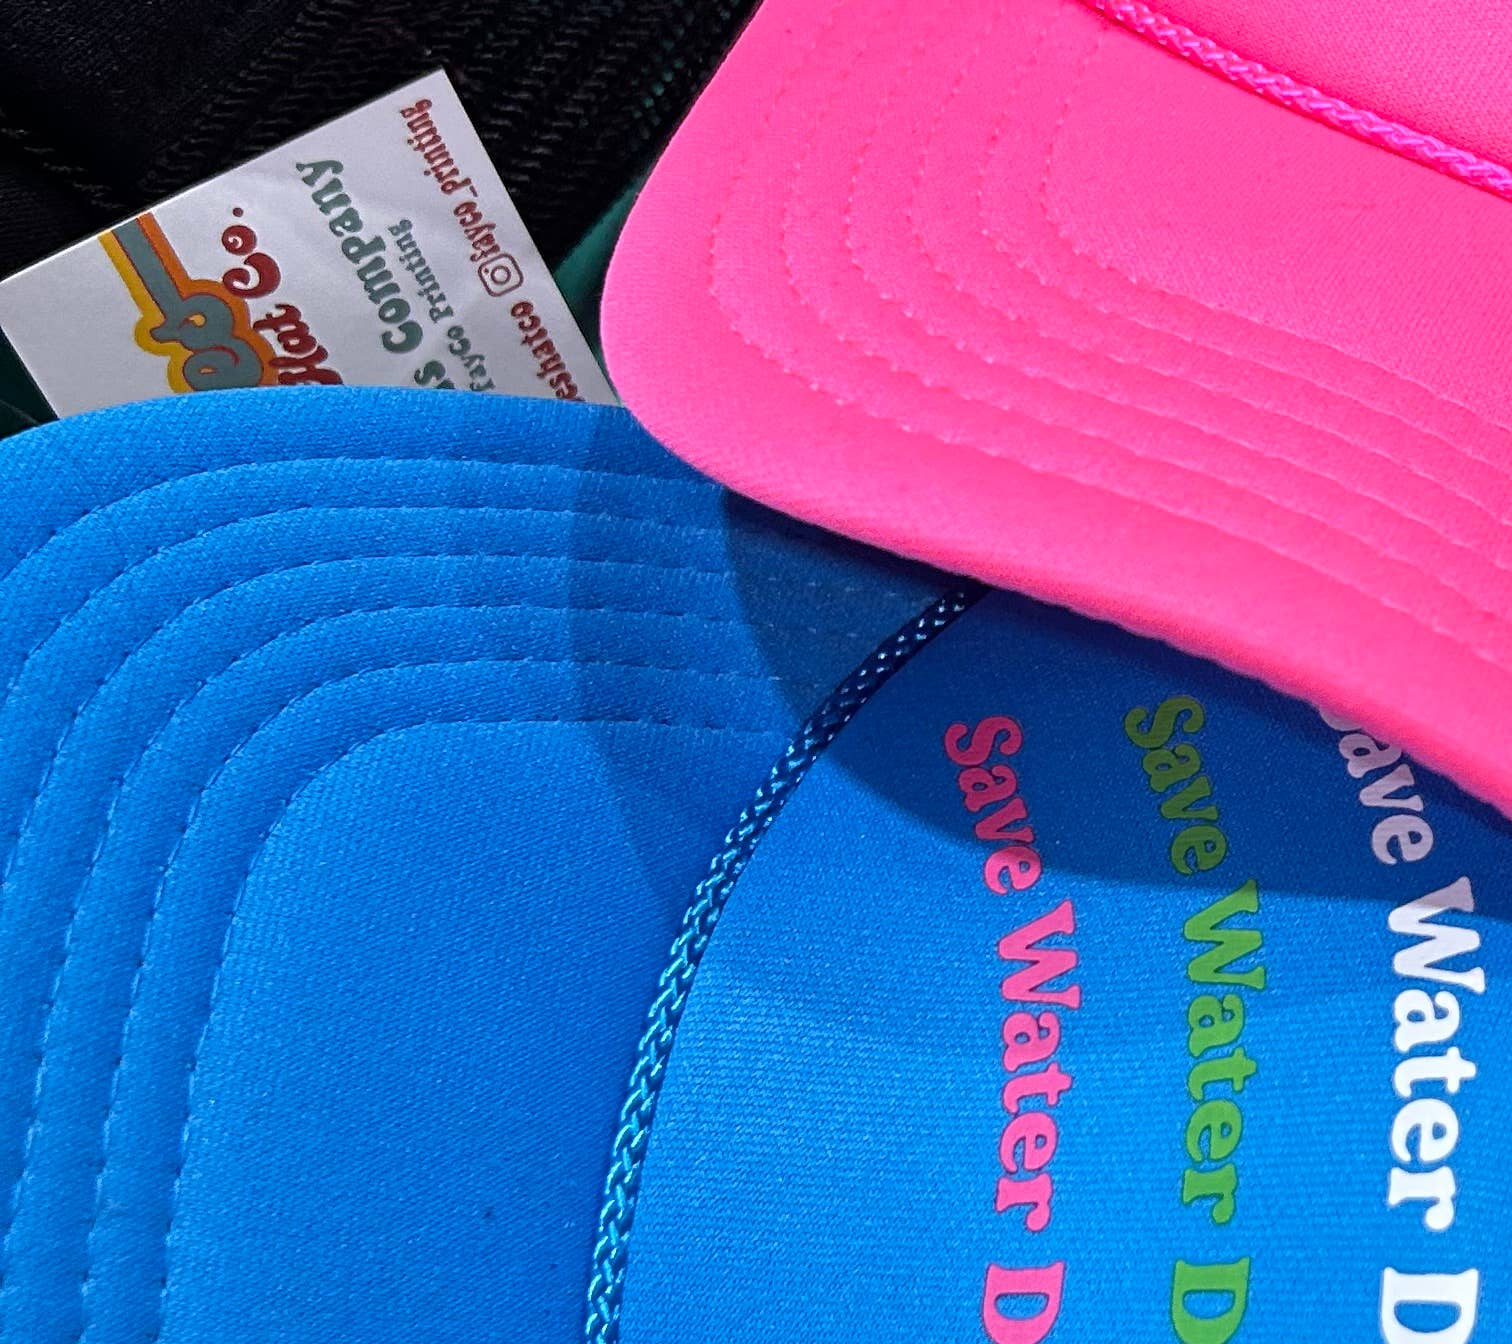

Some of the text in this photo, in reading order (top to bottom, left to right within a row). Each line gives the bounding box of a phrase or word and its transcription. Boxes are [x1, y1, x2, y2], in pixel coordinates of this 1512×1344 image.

[220, 207, 282, 299] Co.
[295, 159, 424, 354] Company
[400, 98, 501, 262] fayco_printing
[387, 218, 455, 324] Printing
[510, 301, 586, 402] eshatco
[943, 714, 1043, 896] Save
[993, 899, 1082, 1233] Water
[1123, 695, 1229, 876] Save
[1181, 878, 1267, 1225] Water
[1386, 875, 1486, 1232] Water
